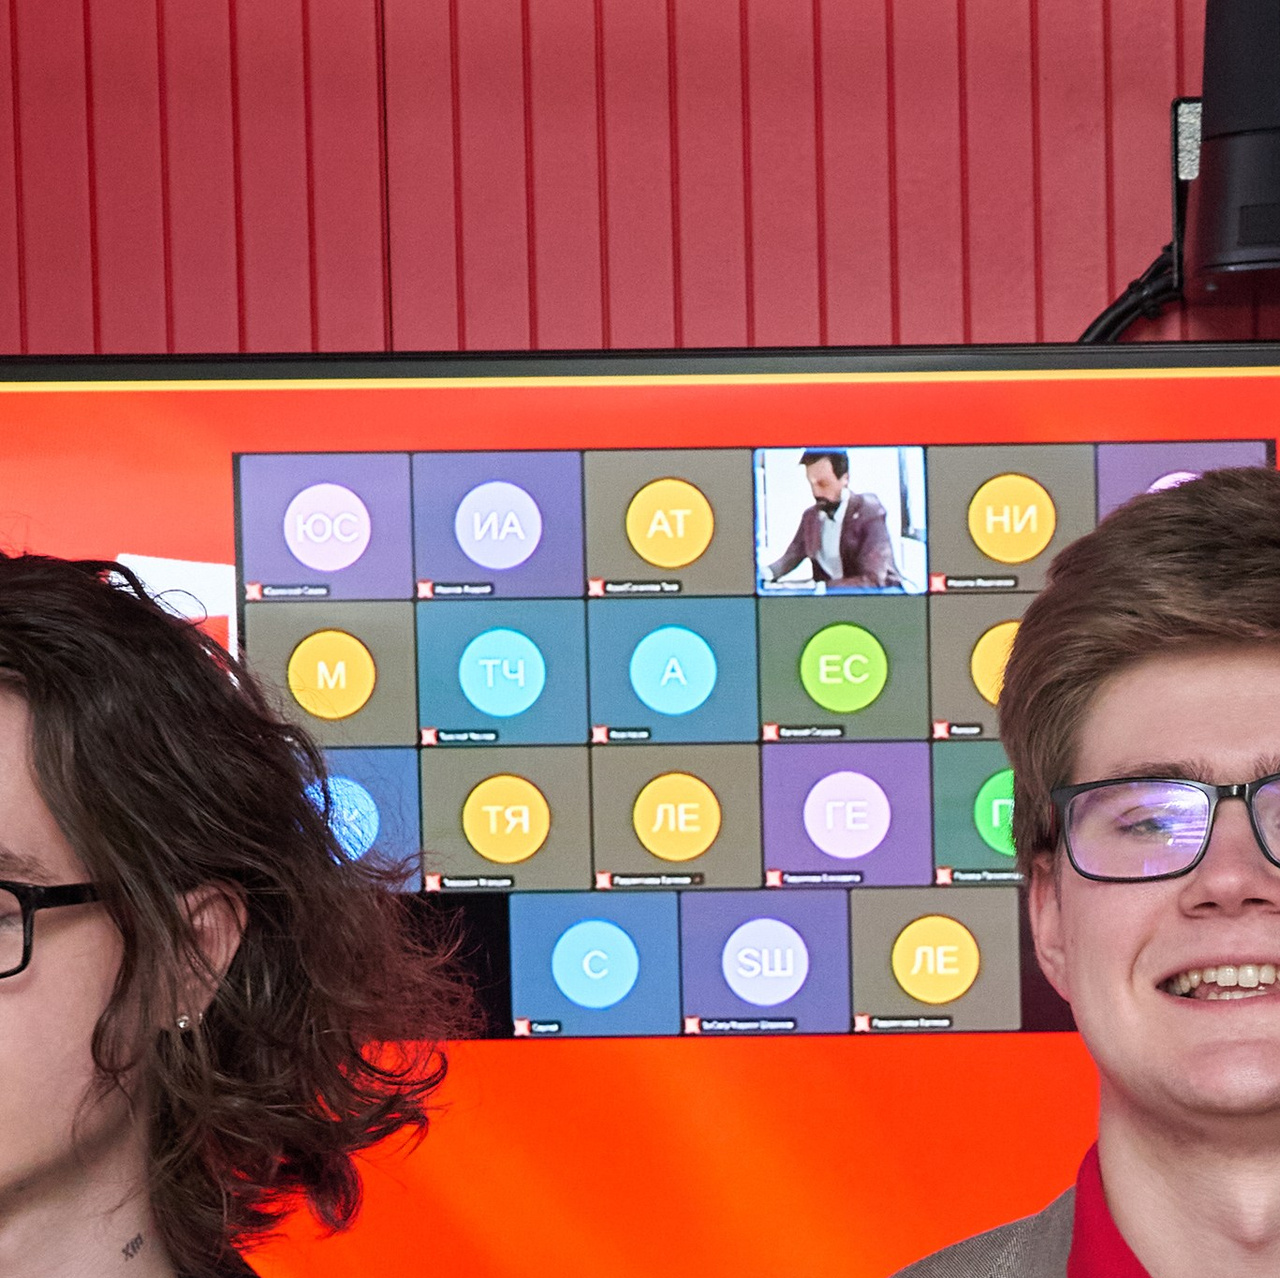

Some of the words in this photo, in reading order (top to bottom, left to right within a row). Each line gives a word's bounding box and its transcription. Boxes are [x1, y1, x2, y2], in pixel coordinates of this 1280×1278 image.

[297, 513, 360, 543] ЮС
[474, 510, 526, 541] ИА
[646, 508, 691, 538] АТ
[986, 505, 1038, 534] НИ
[316, 660, 346, 689] М
[478, 658, 525, 688] ТЧ
[660, 658, 688, 687] А
[818, 654, 869, 683] ЕС
[481, 805, 530, 834] ТЯ
[651, 803, 701, 833] ЛЕ
[825, 800, 868, 830] ГЕ
[582, 950, 608, 980] С
[911, 945, 959, 975] ЛЕ
